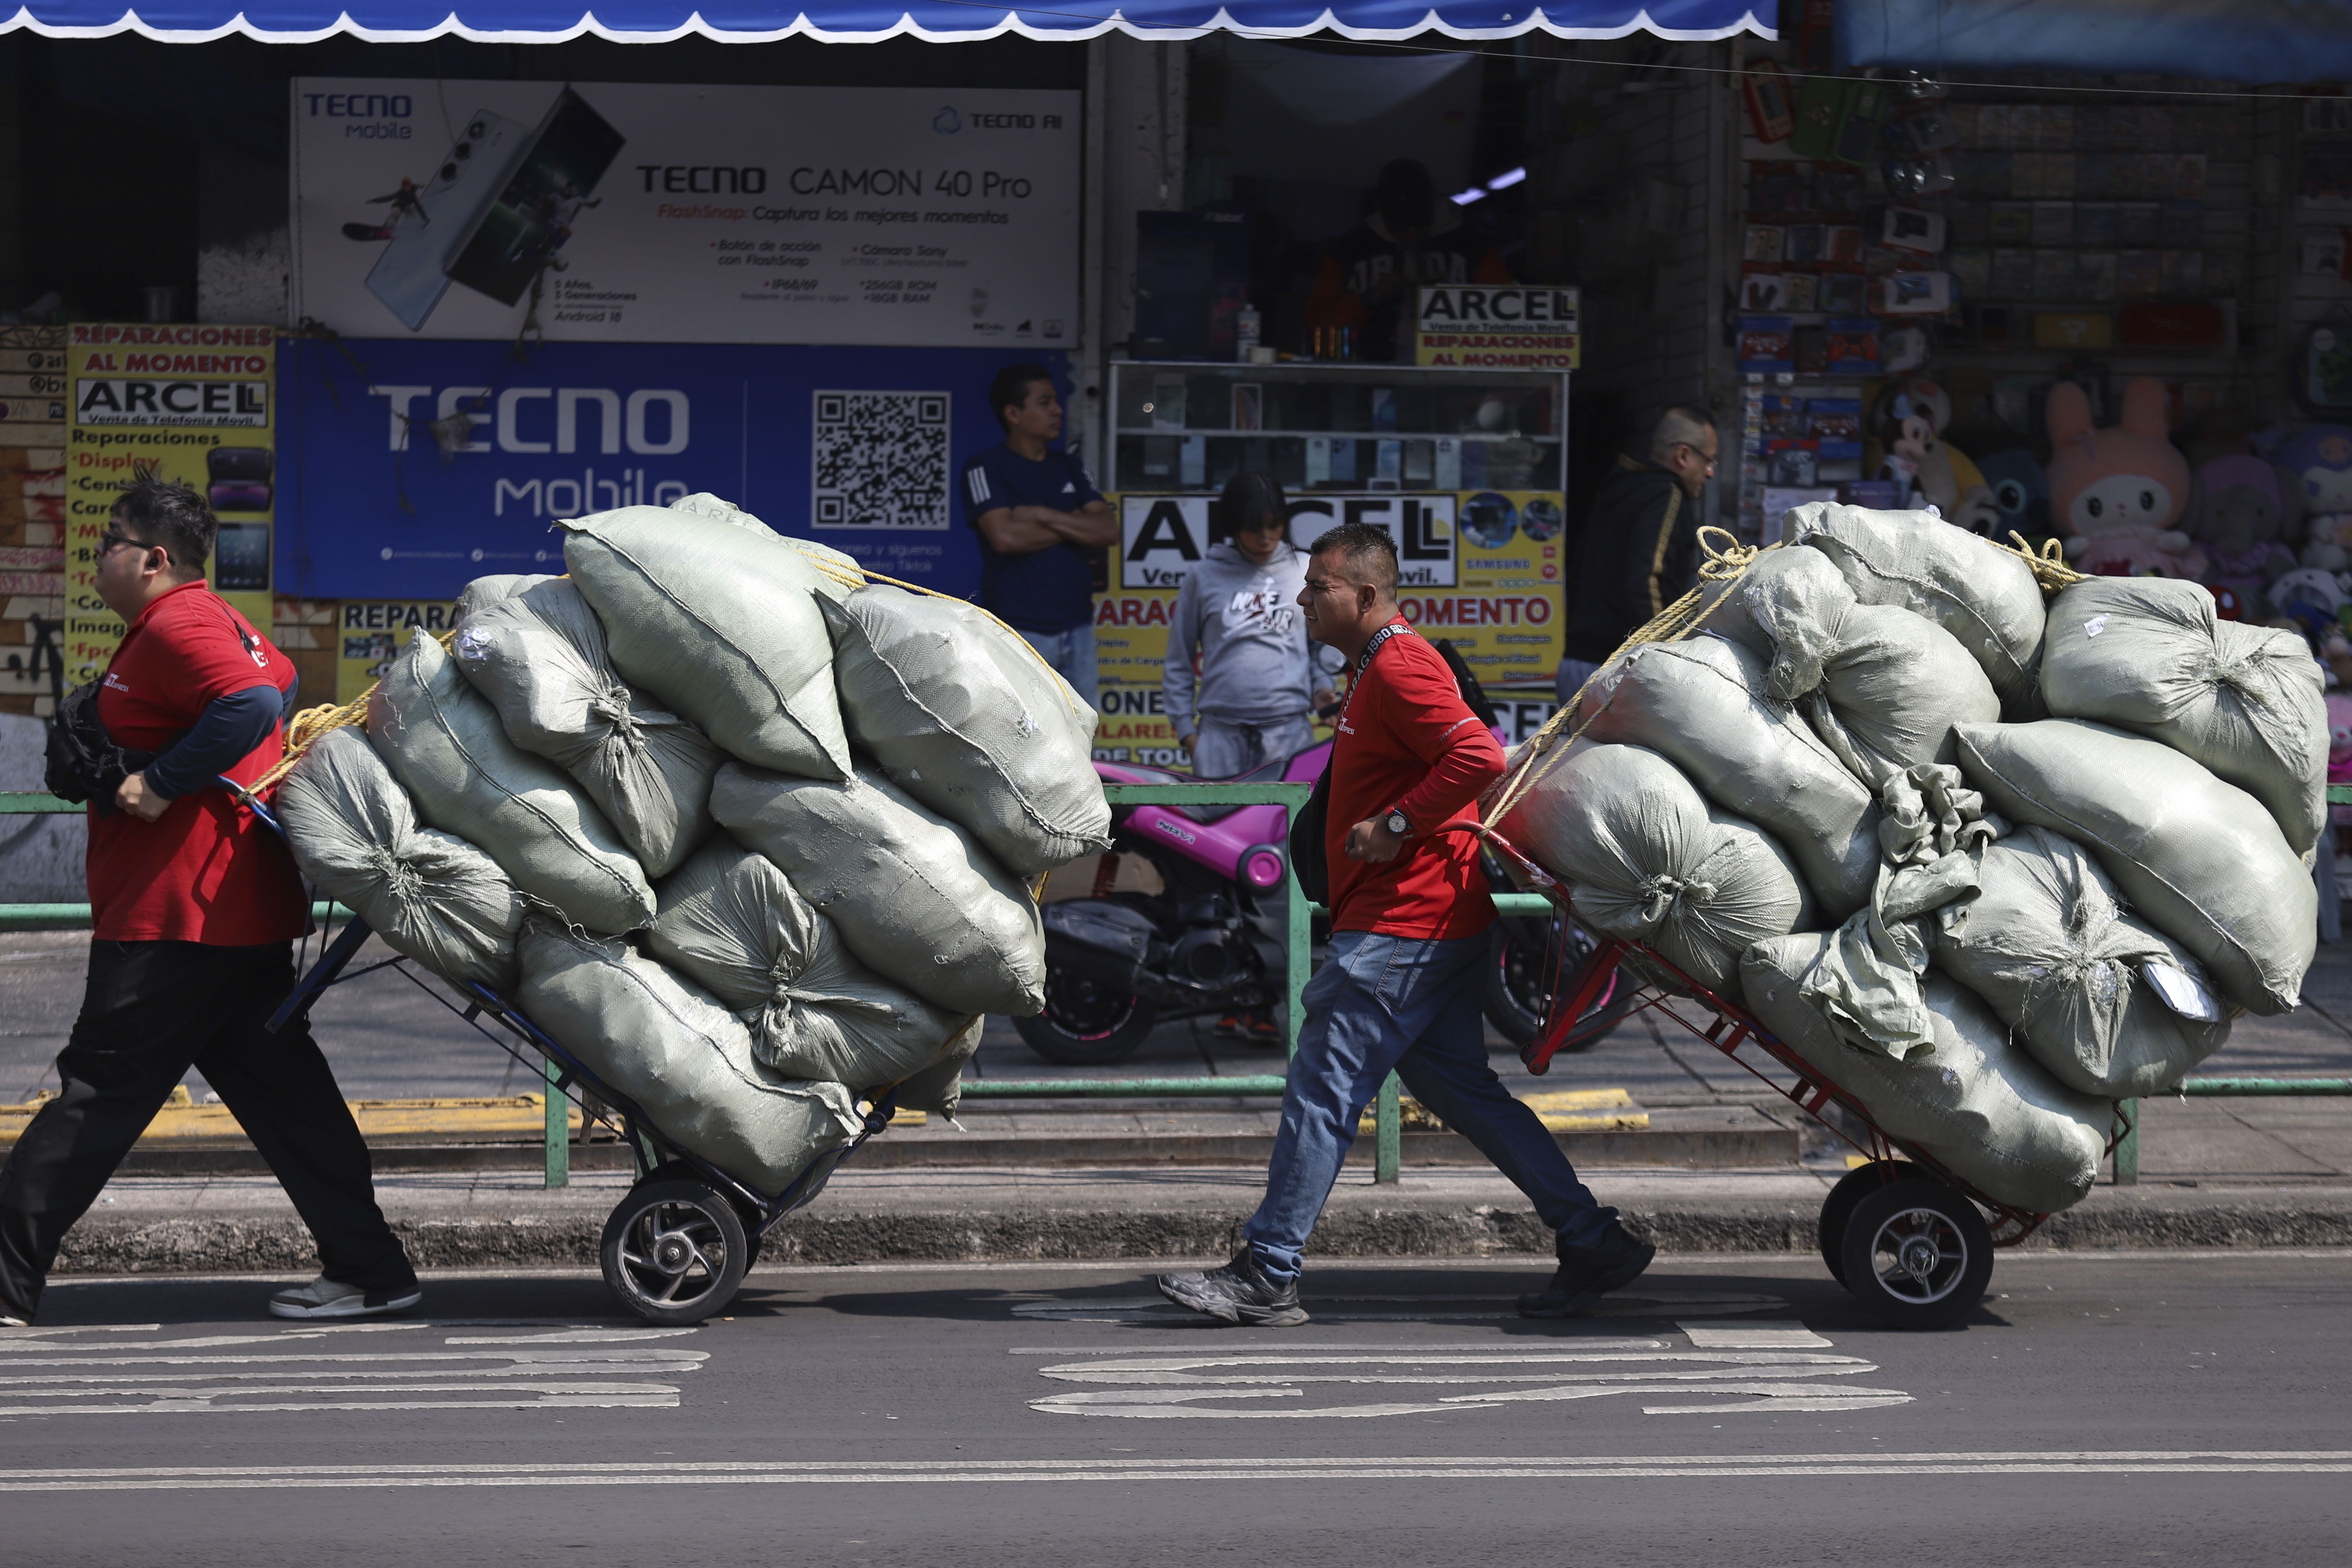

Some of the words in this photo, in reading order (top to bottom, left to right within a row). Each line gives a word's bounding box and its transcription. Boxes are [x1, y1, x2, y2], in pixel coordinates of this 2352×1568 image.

[303, 94, 412, 118] TECNO
[970, 113, 1036, 129] TECNO
[1042, 115, 1062, 129] AI
[636, 165, 767, 194] TECNO
[790, 167, 922, 196] CAMON
[935, 170, 973, 196] 40
[984, 171, 1032, 198] Pro
[752, 206, 820, 223] Captura
[825, 208, 849, 222] los
[854, 208, 918, 226] mejores
[923, 209, 1010, 224] momentos
[759, 240, 776, 252] de
[916, 245, 949, 258] Sony
[717, 255, 741, 266] con
[74, 325, 272, 347] REPARACIONES
[1424, 336, 1575, 349] REPARACIONES
[85, 352, 117, 372] AL
[125, 353, 266, 374] MOMENTO
[1432, 354, 1458, 366] AL
[1463, 355, 1569, 367] MOMENTO
[88, 414, 129, 424] Venta
[132, 414, 147, 424] de
[369, 384, 689, 454] TECNO
[72, 429, 221, 447] Reparaciones
